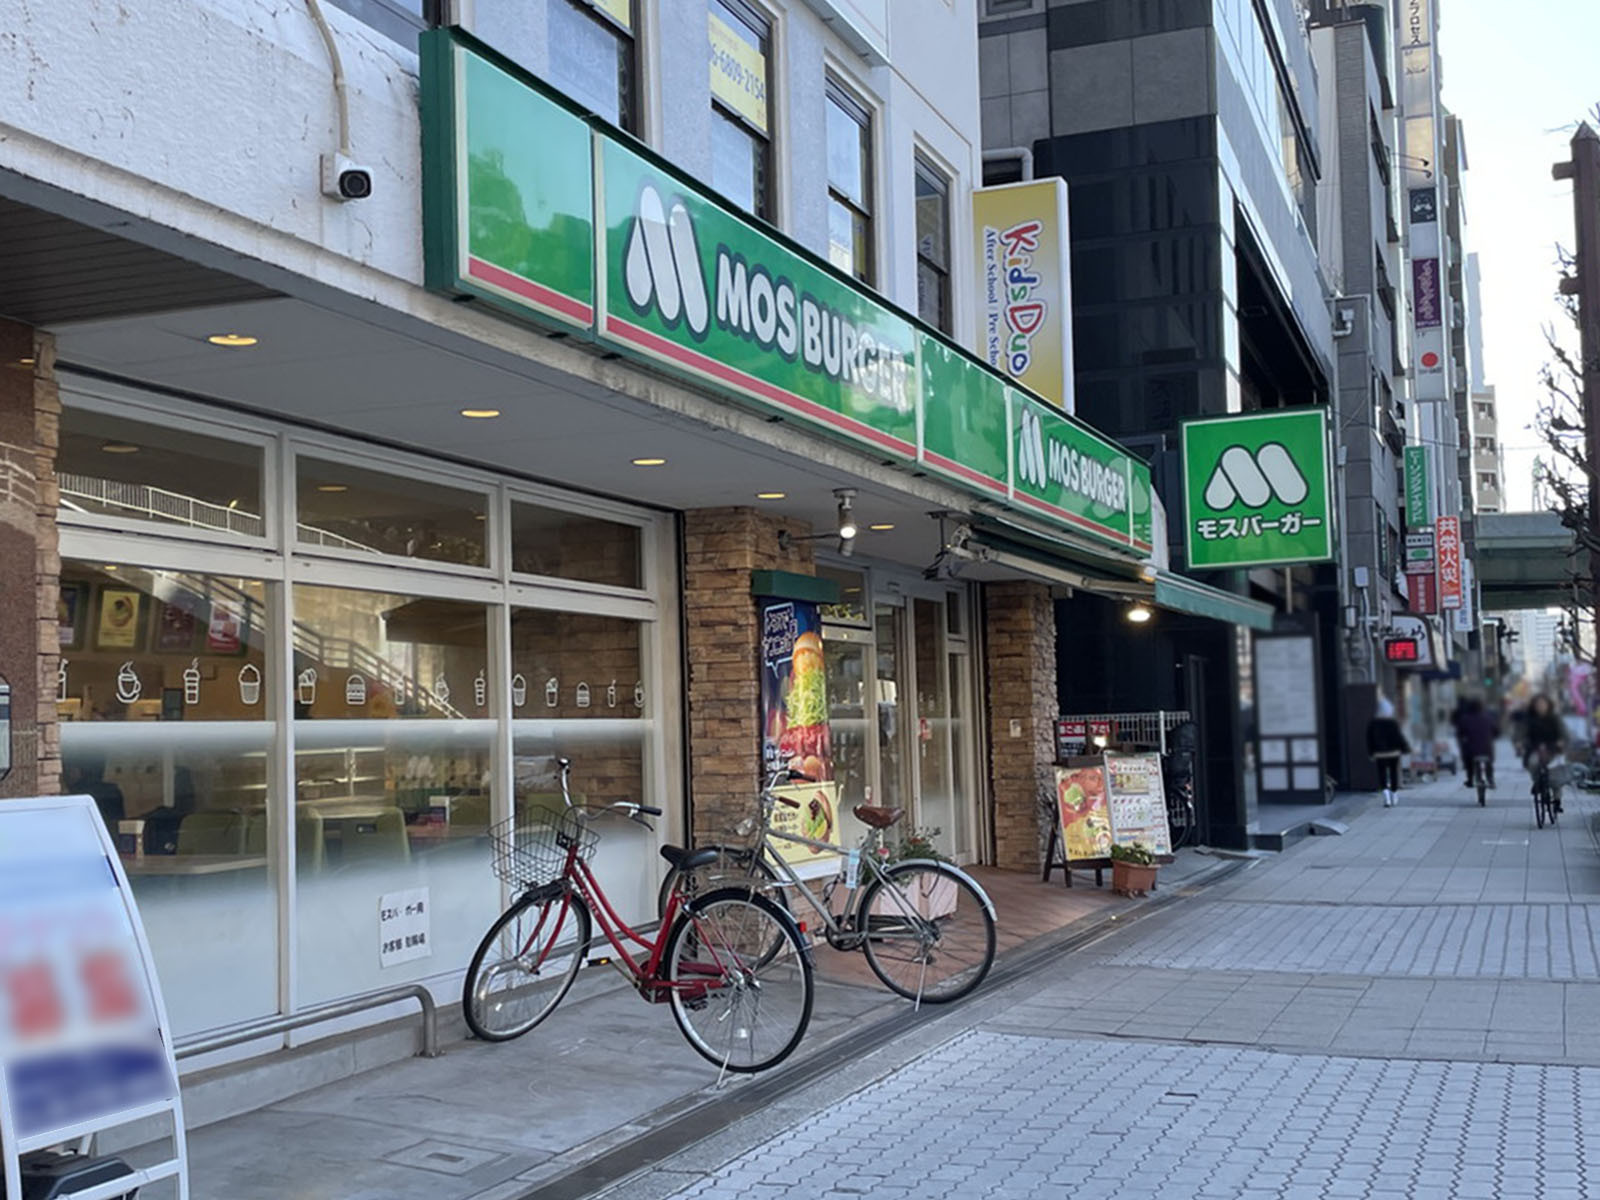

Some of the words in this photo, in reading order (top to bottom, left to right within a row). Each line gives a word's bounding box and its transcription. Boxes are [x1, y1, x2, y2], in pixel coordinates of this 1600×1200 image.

[985, 228, 997, 260] After
[986, 262, 999, 304] School
[716, 252, 798, 355] MOS
[803, 299, 909, 412] BURGER
[988, 313, 999, 335] Pre
[1048, 437, 1079, 492] MOS
[1080, 455, 1126, 513] BURGER
[1197, 512, 1321, 540] モスバーガー
[1439, 519, 1457, 584] 共栄火災
